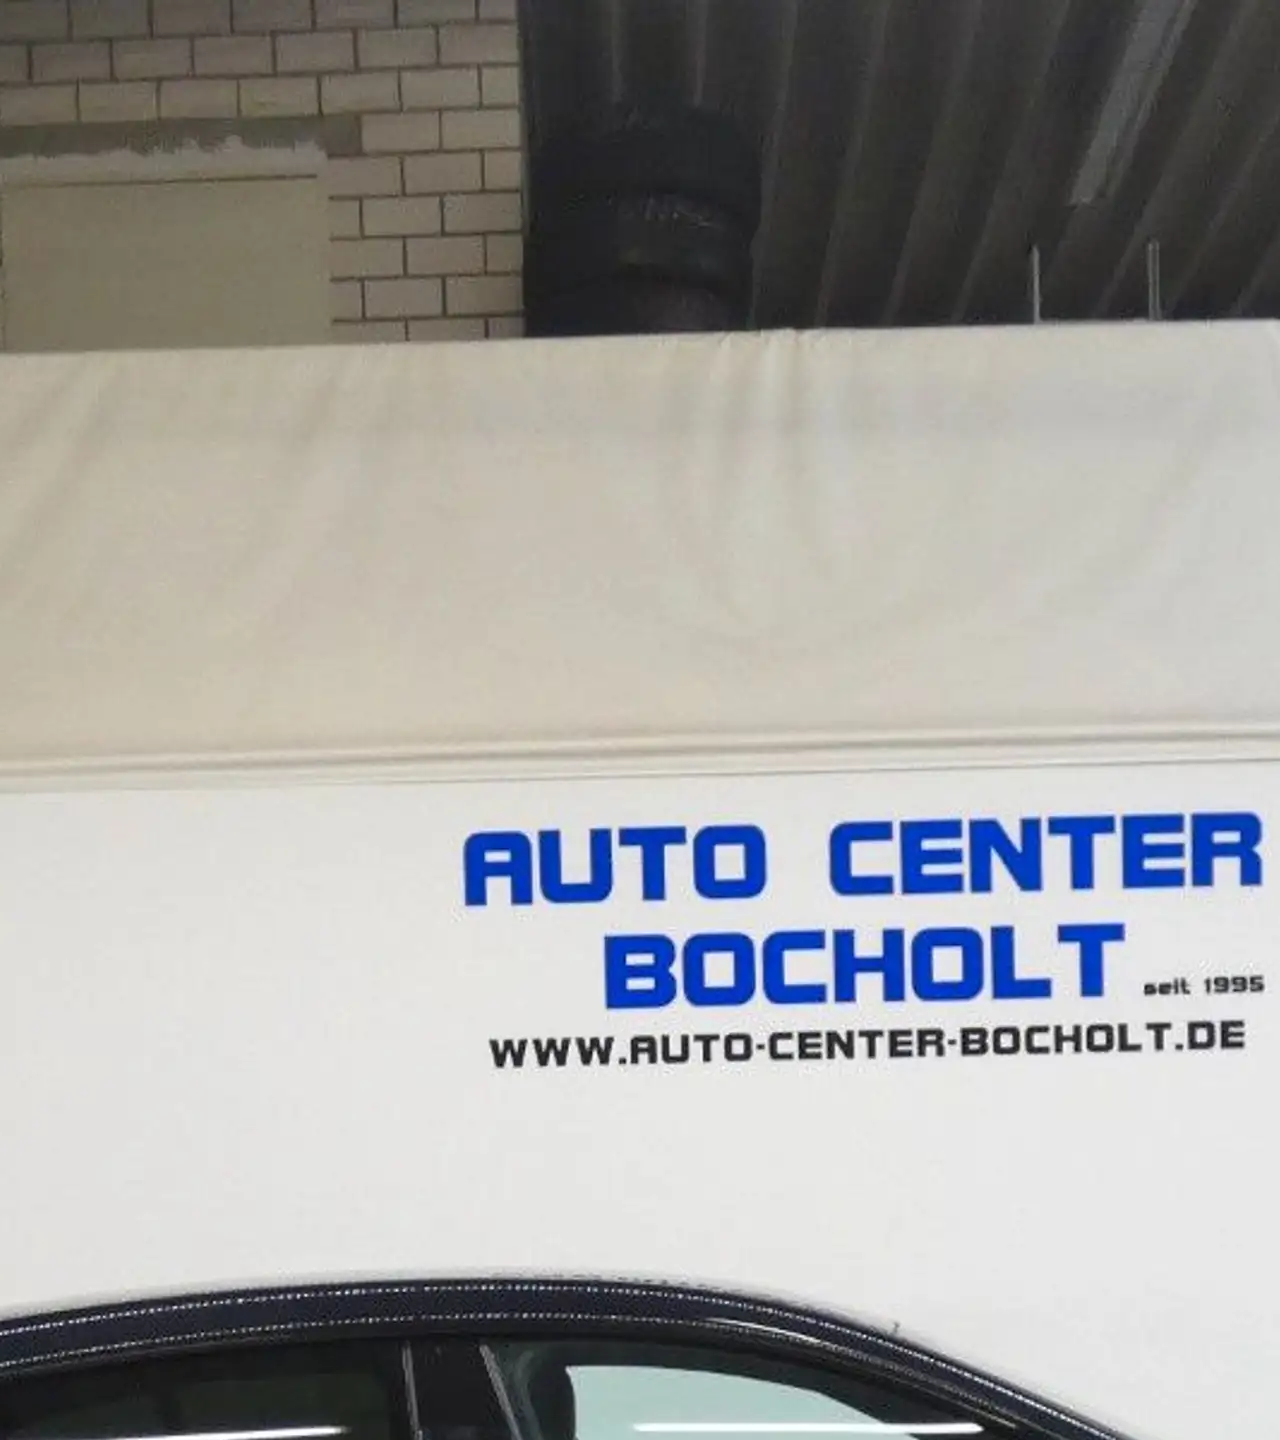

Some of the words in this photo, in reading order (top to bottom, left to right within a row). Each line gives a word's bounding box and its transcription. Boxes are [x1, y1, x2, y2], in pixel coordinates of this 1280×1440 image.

[464, 824, 768, 907] AUTO
[830, 811, 1263, 895] CENTER
[604, 922, 1125, 1010] BOCHOLT
[1143, 977, 1191, 996] seit
[1204, 975, 1265, 994] 1995
[489, 1020, 1246, 1069] WWW.AUTO-CENTER-BOCHOLT.DE
